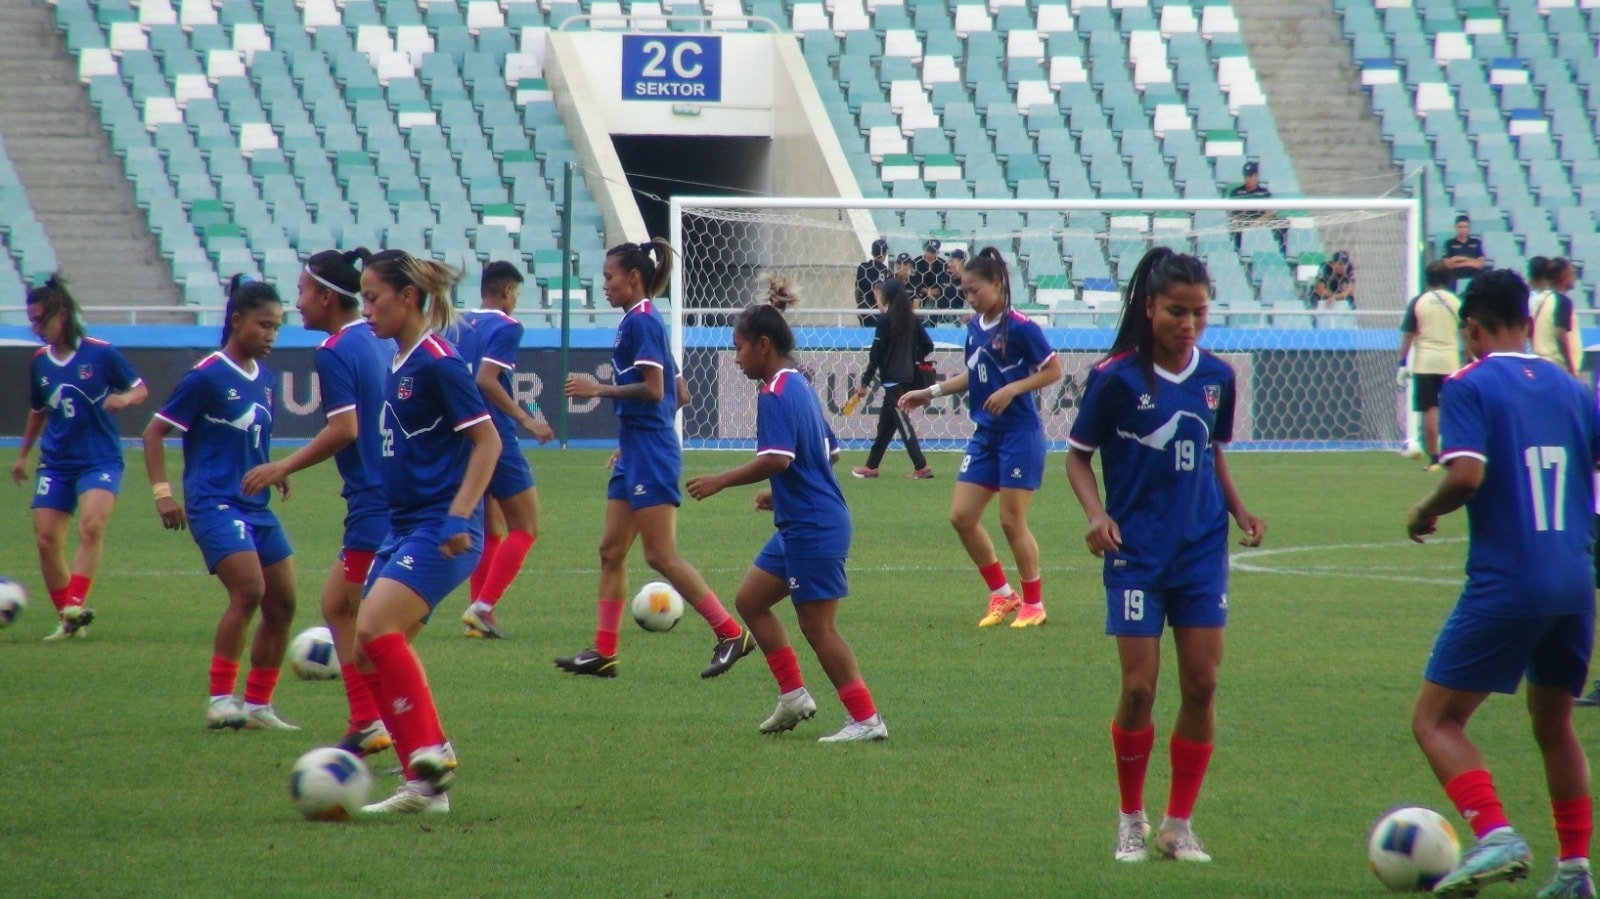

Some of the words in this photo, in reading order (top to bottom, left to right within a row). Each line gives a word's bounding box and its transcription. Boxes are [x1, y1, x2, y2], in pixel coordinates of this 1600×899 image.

[641, 40, 703, 79] 2C
[635, 82, 705, 96] SEKTOR
[977, 362, 988, 383] 18
[61, 398, 76, 418] 15
[253, 424, 262, 449] 7
[1174, 440, 1195, 472] 19
[36, 476, 52, 496] 15
[1524, 446, 1567, 531] 17
[234, 520, 247, 540] 7
[1123, 589, 1144, 621] 19
